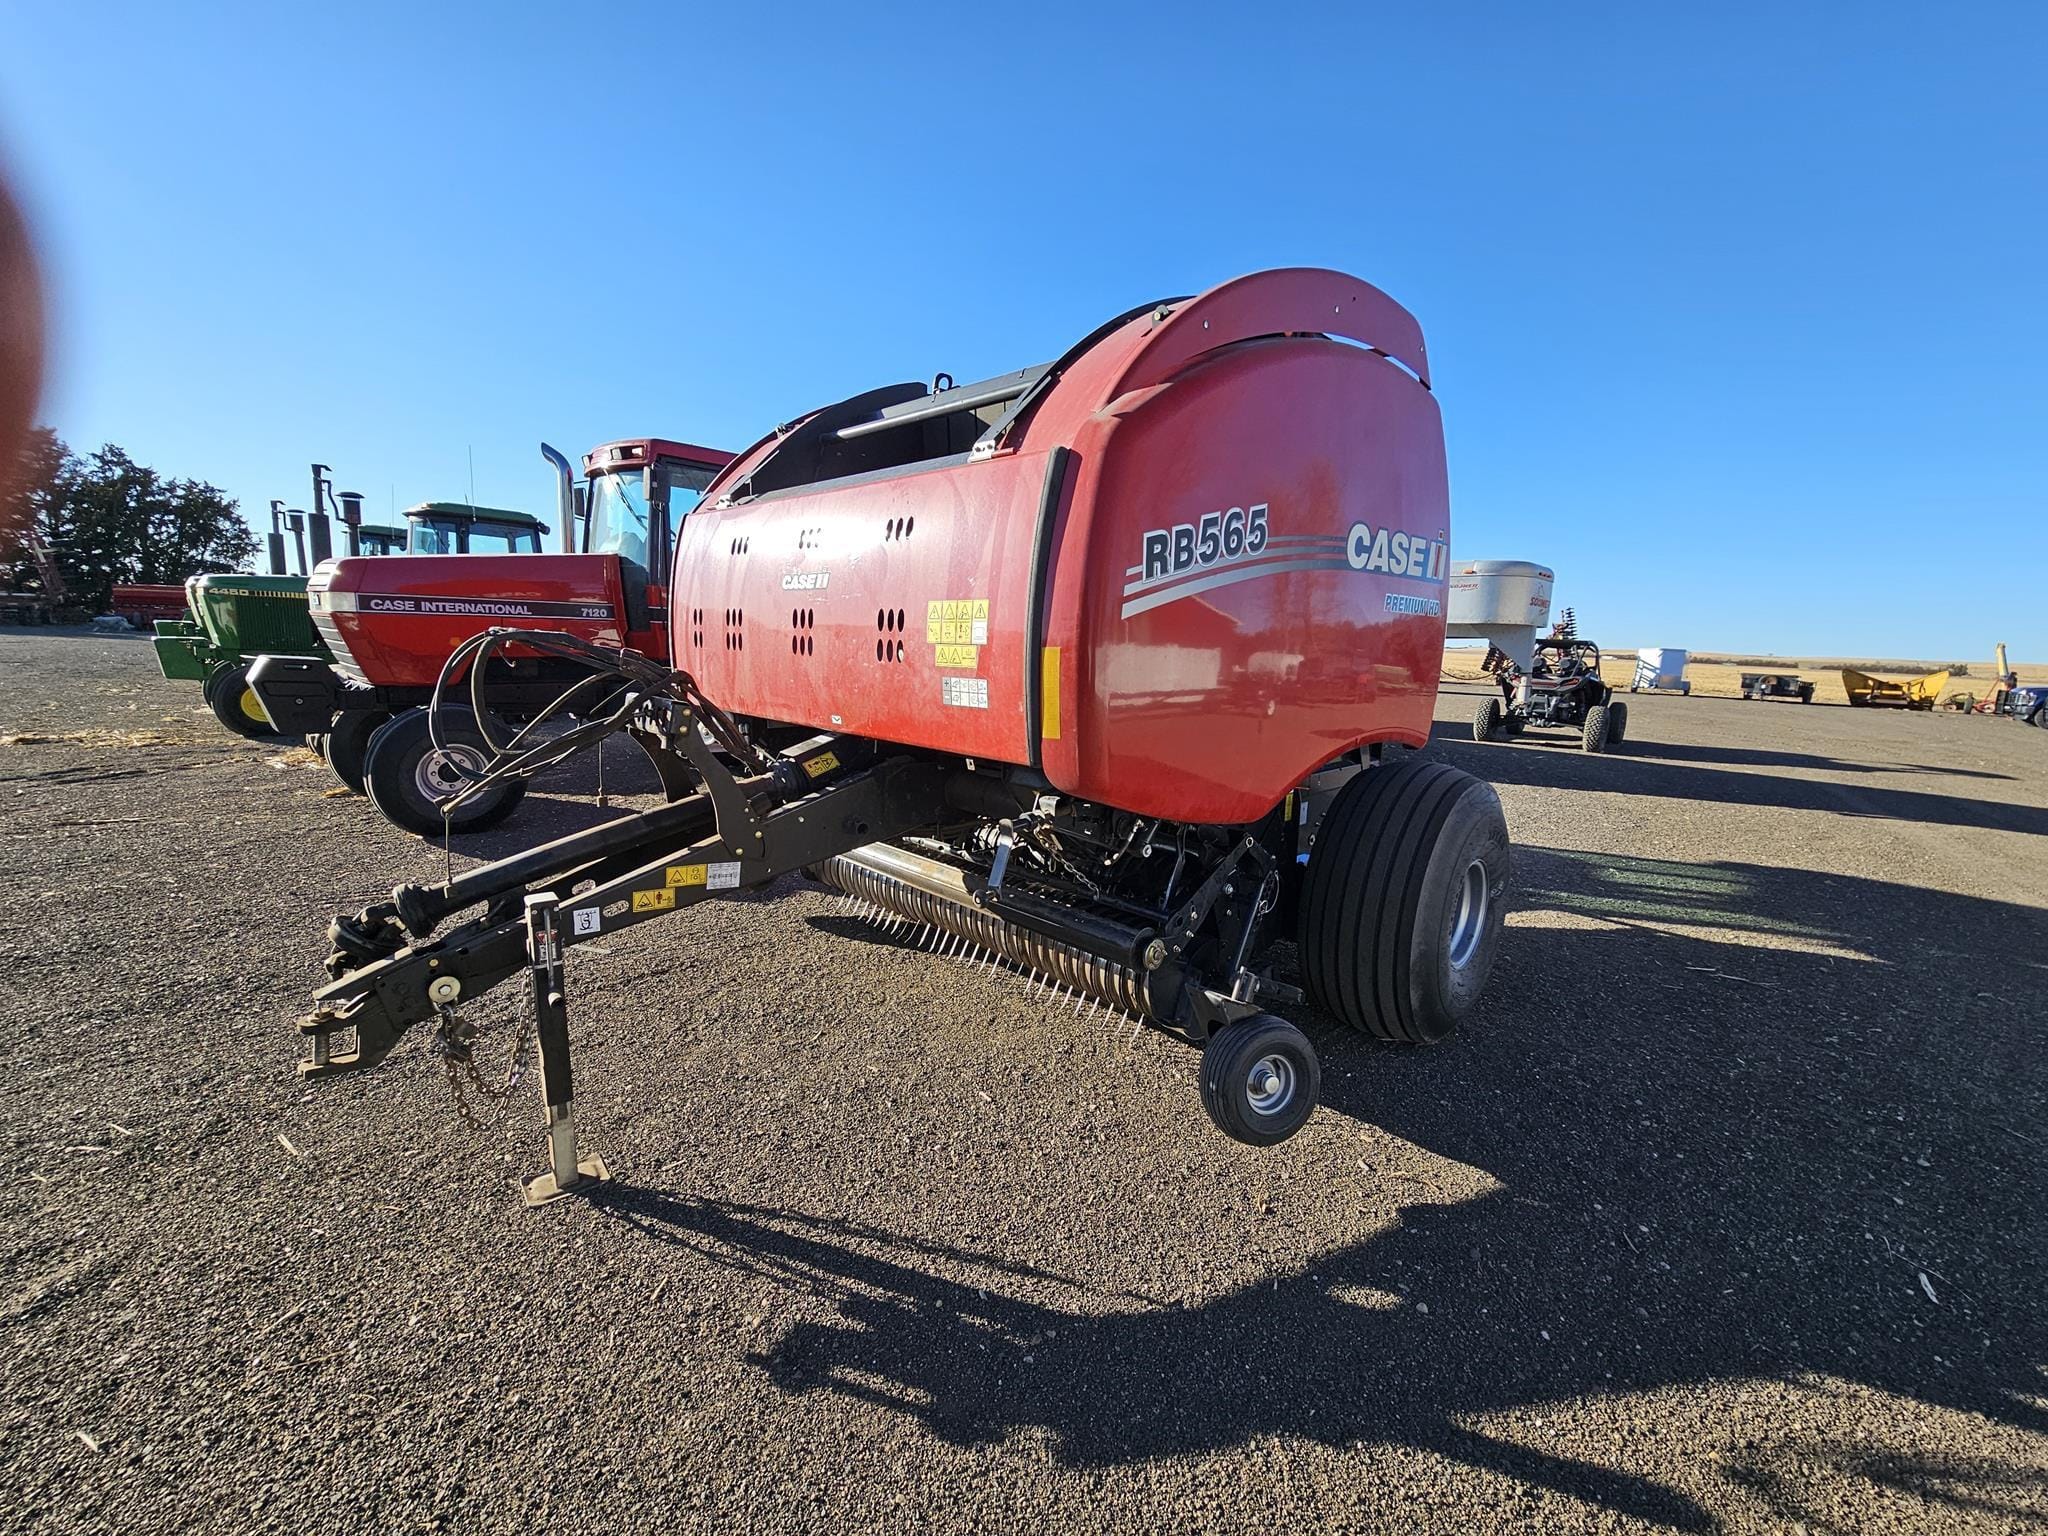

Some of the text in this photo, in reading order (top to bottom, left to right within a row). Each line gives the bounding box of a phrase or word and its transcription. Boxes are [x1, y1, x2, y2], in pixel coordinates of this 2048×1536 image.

[1142, 503, 1268, 584] RB565
[1346, 522, 1427, 577] CASE
[782, 573, 817, 590] CASE
[208, 587, 250, 597] 4450
[370, 599, 532, 615] CASE INTERNATIONAL
[581, 607, 607, 618] 7120
[1384, 593, 1441, 617] PREMIUM HD
